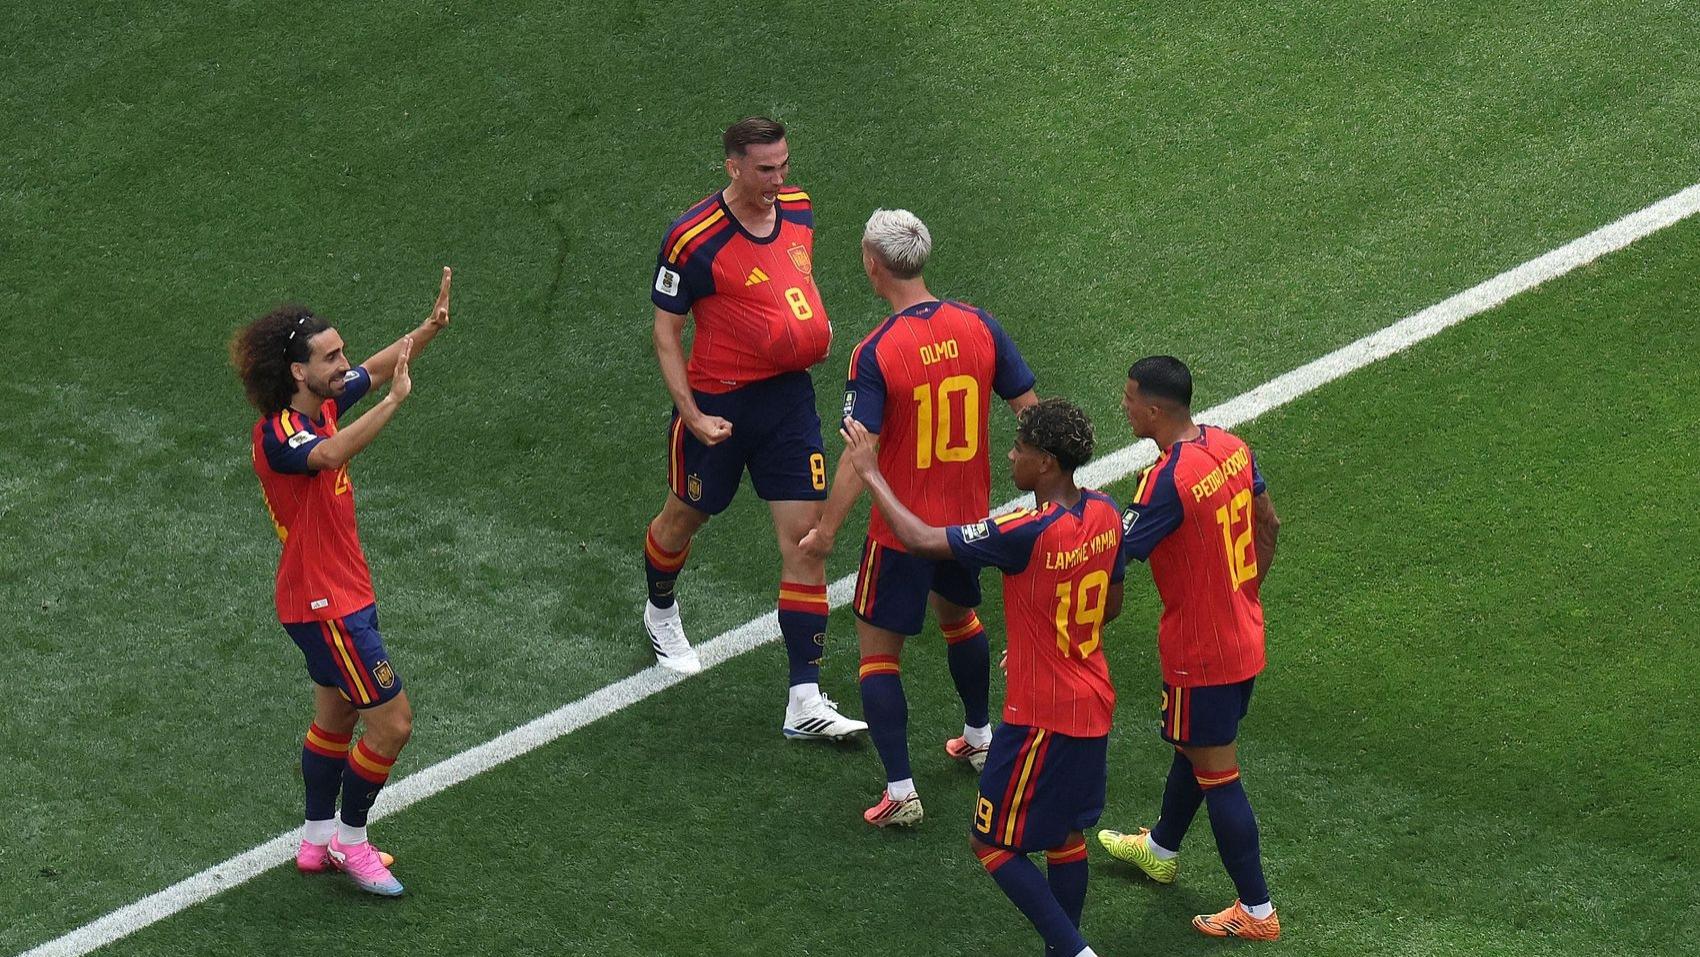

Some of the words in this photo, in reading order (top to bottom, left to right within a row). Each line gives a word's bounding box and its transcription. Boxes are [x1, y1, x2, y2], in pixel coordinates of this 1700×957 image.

[784, 287, 813, 320] 8
[920, 339, 959, 366] OLMO
[913, 374, 979, 469] 10
[809, 452, 826, 491] 8
[1215, 488, 1258, 592] 12
[1056, 570, 1109, 659] 19
[974, 789, 993, 834] 9
